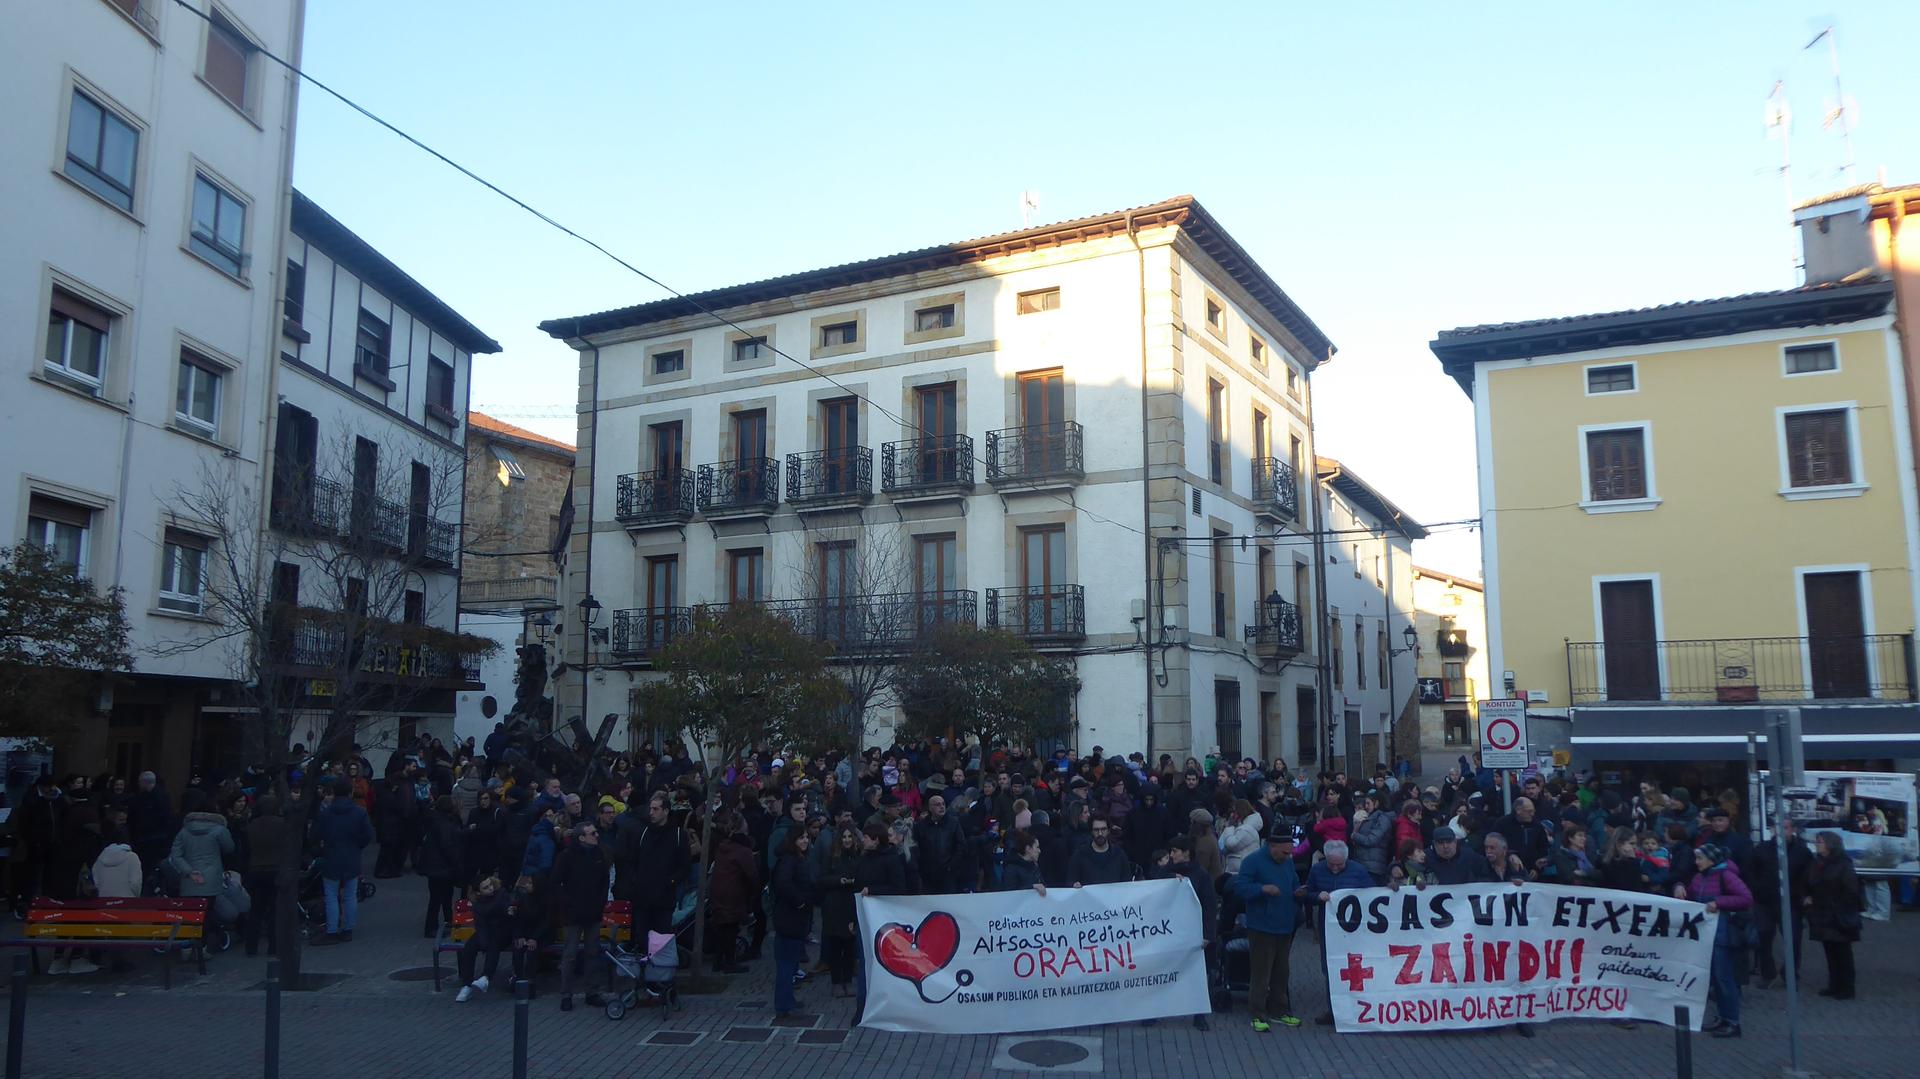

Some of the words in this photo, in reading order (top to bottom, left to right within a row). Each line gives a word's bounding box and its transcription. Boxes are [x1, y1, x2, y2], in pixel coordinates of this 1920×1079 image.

[988, 917, 1044, 933] pediatras
[1050, 914, 1065, 925] en
[1069, 909, 1118, 927] Altsasu
[1121, 905, 1144, 920] YA!
[1336, 893, 1531, 933] OSASUN
[1553, 896, 1703, 940] ETXEAK
[973, 931, 1068, 955] Altsasun
[1013, 941, 1137, 978] ORAIN!
[957, 991, 994, 1004] OSASUN
[996, 988, 1039, 1002] PUBLIKOA
[1042, 987, 1058, 999] ETA
[1061, 981, 1121, 997] KALITATEZKOA
[1124, 971, 1180, 990] GUZTIENTZAT
